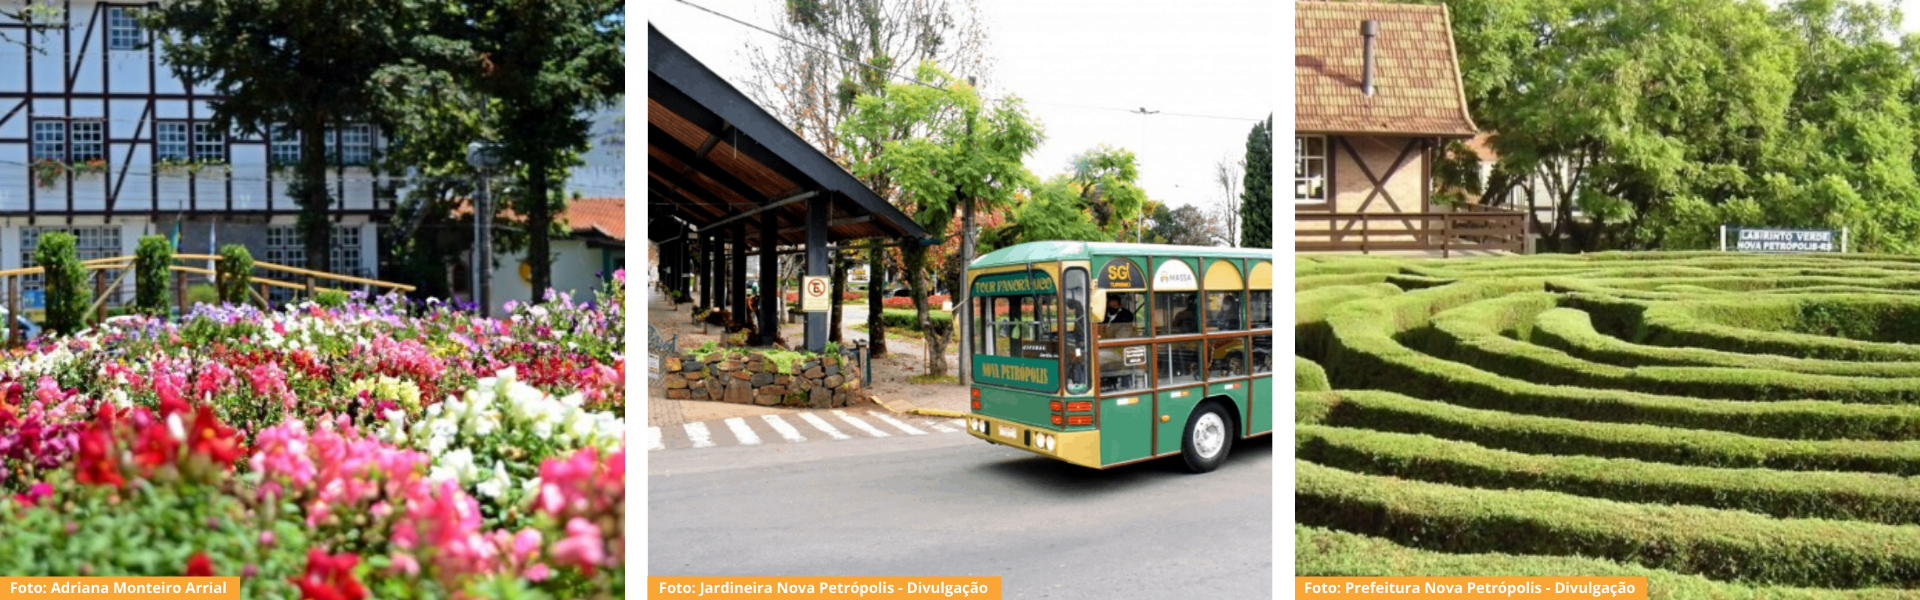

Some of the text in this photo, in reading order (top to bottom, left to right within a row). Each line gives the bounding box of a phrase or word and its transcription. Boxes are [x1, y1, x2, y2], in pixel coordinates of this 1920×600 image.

[1742, 230, 1829, 240] LABIRINTO VERDE
[1737, 241, 1761, 250] NOVA
[975, 281, 996, 293] TOUR
[982, 362, 1048, 385] NOVA PETRÓPOLIS
